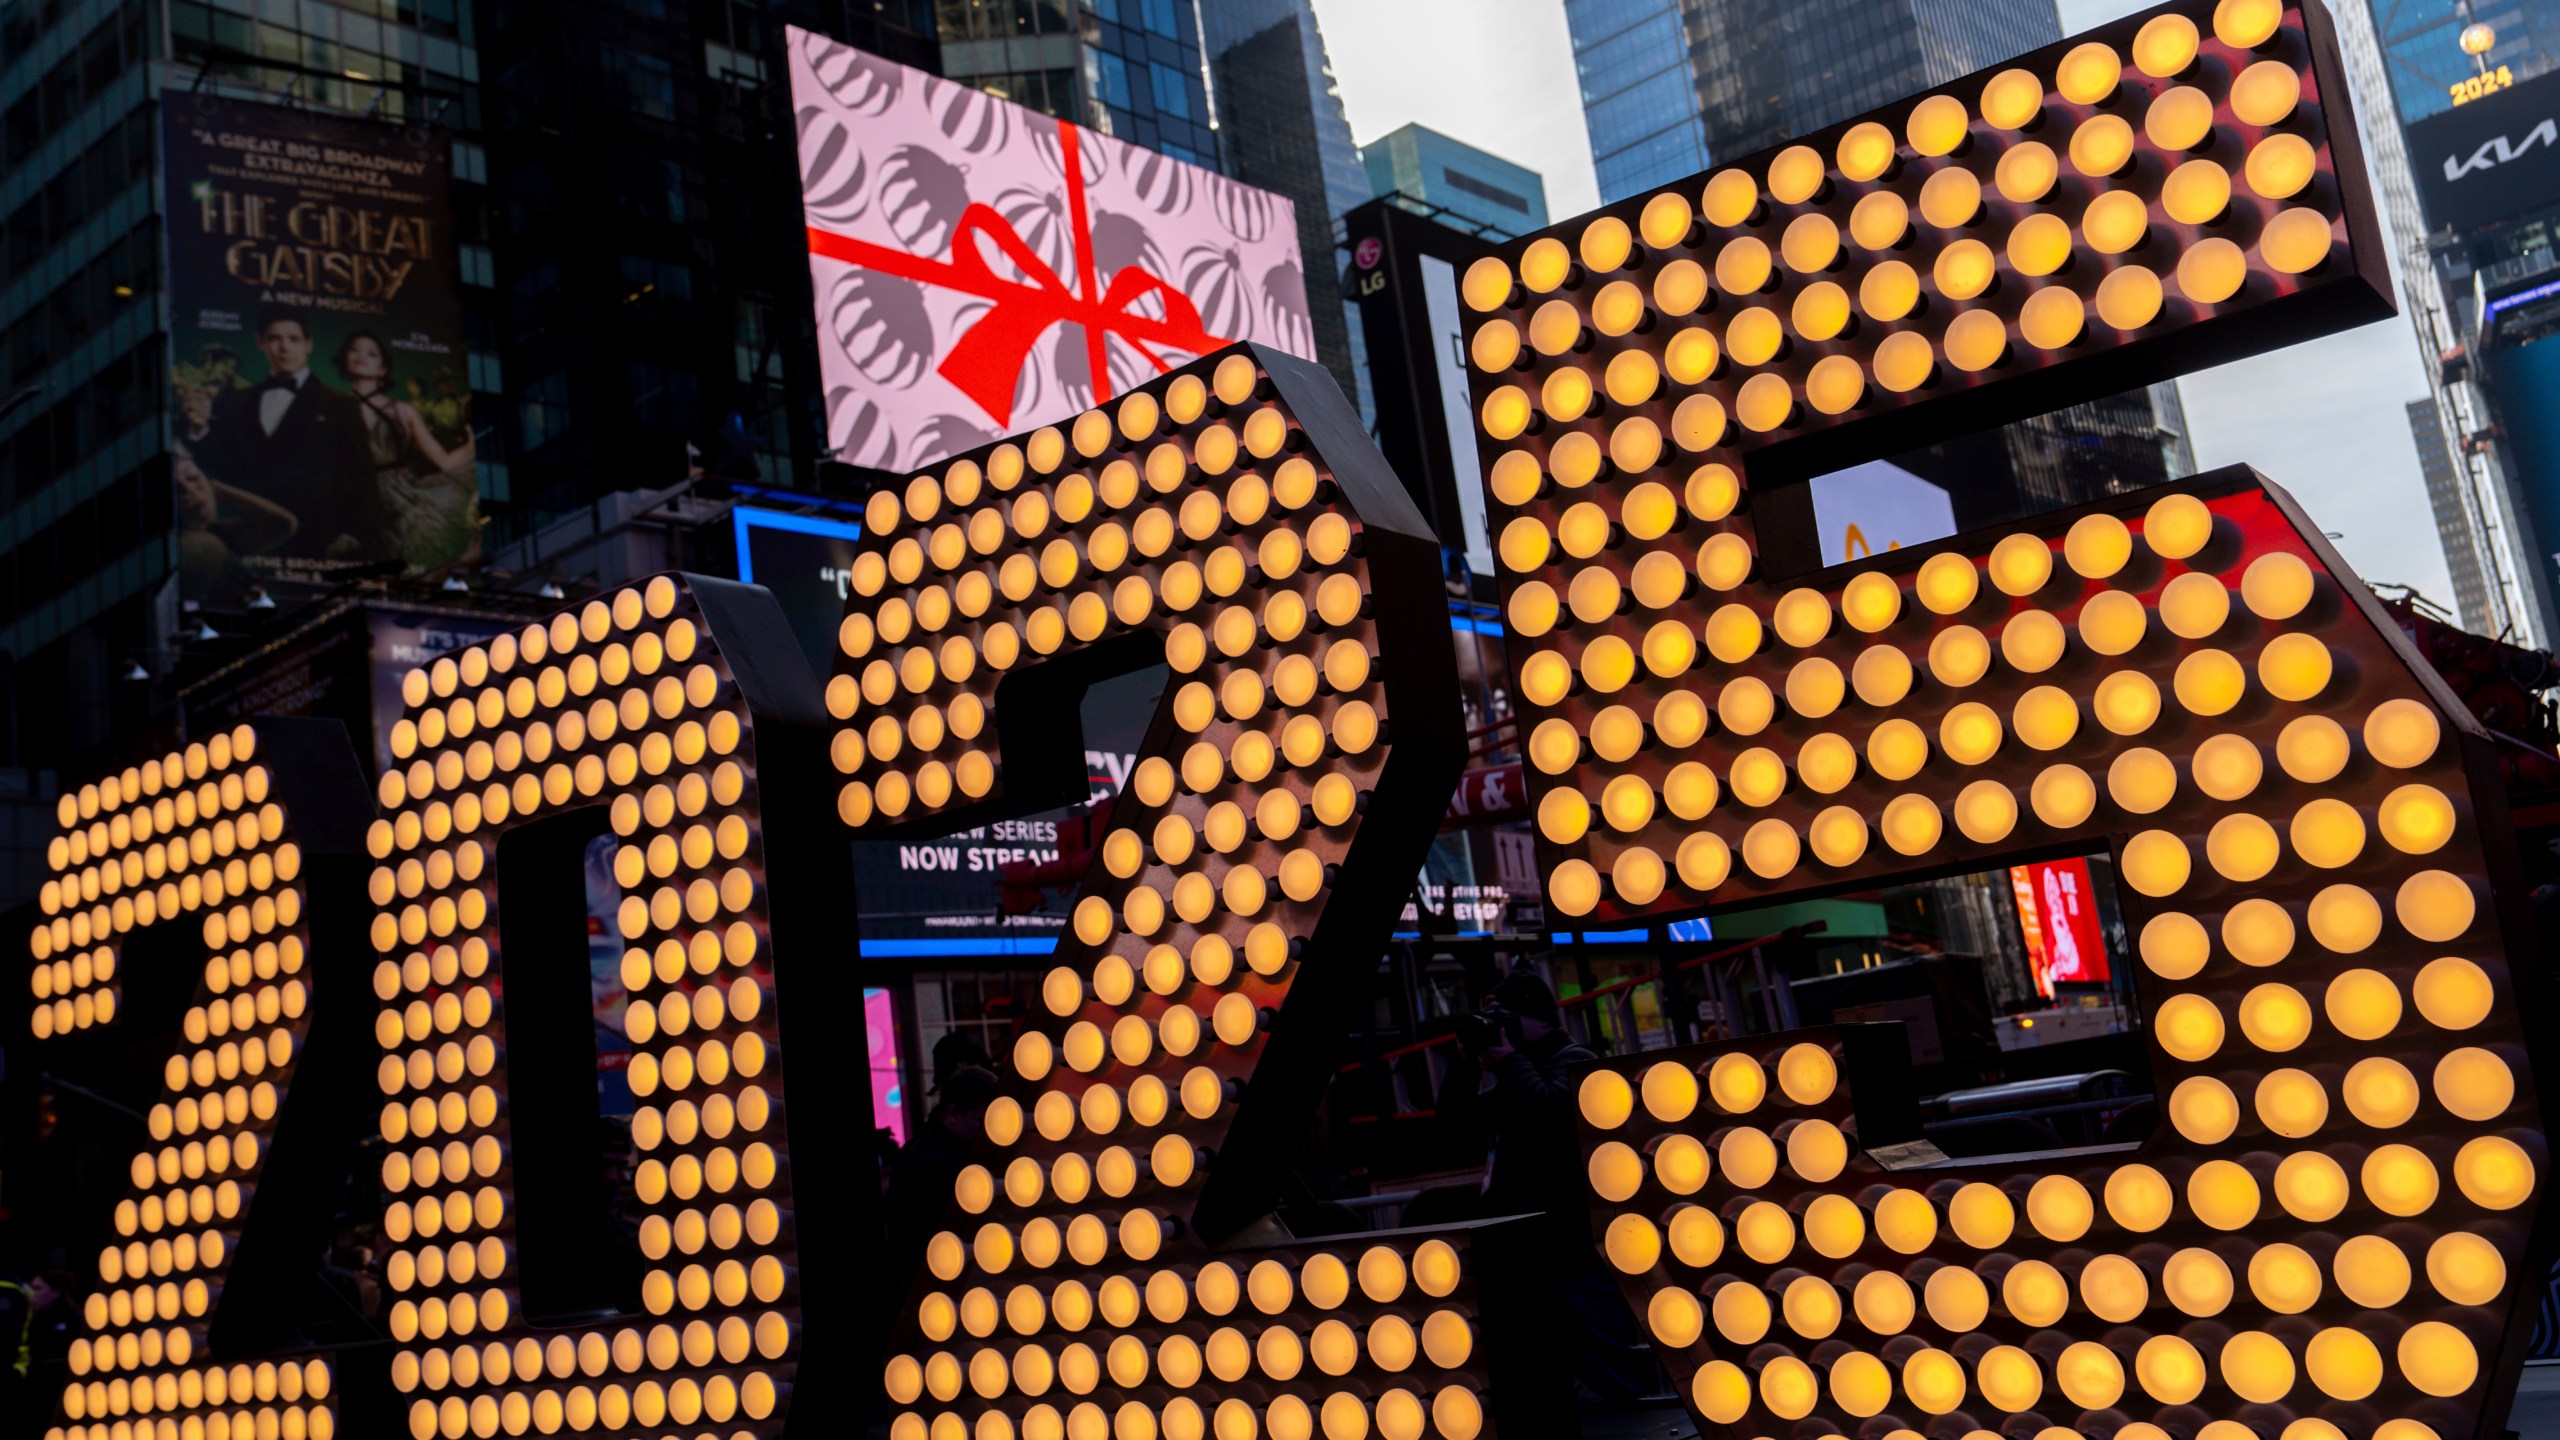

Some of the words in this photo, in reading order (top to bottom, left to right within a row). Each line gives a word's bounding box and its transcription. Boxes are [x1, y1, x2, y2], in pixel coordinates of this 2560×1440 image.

[2449, 65, 2513, 107] 2024
[217, 132, 282, 154] GREAT
[286, 141, 321, 161] BIG
[323, 146, 427, 178] BROADWAY
[244, 153, 393, 189] EXTRAVAGANZA
[200, 189, 278, 241] THE
[286, 201, 437, 261] GREAT
[225, 239, 414, 300] GATSBY
[1361, 271, 1385, 295] LG
[261, 289, 275, 303] A
[275, 291, 314, 307] NEW
[315, 296, 385, 316] MUSICAL
[991, 820, 1059, 843] SERIES
[900, 845, 959, 872] NOW
